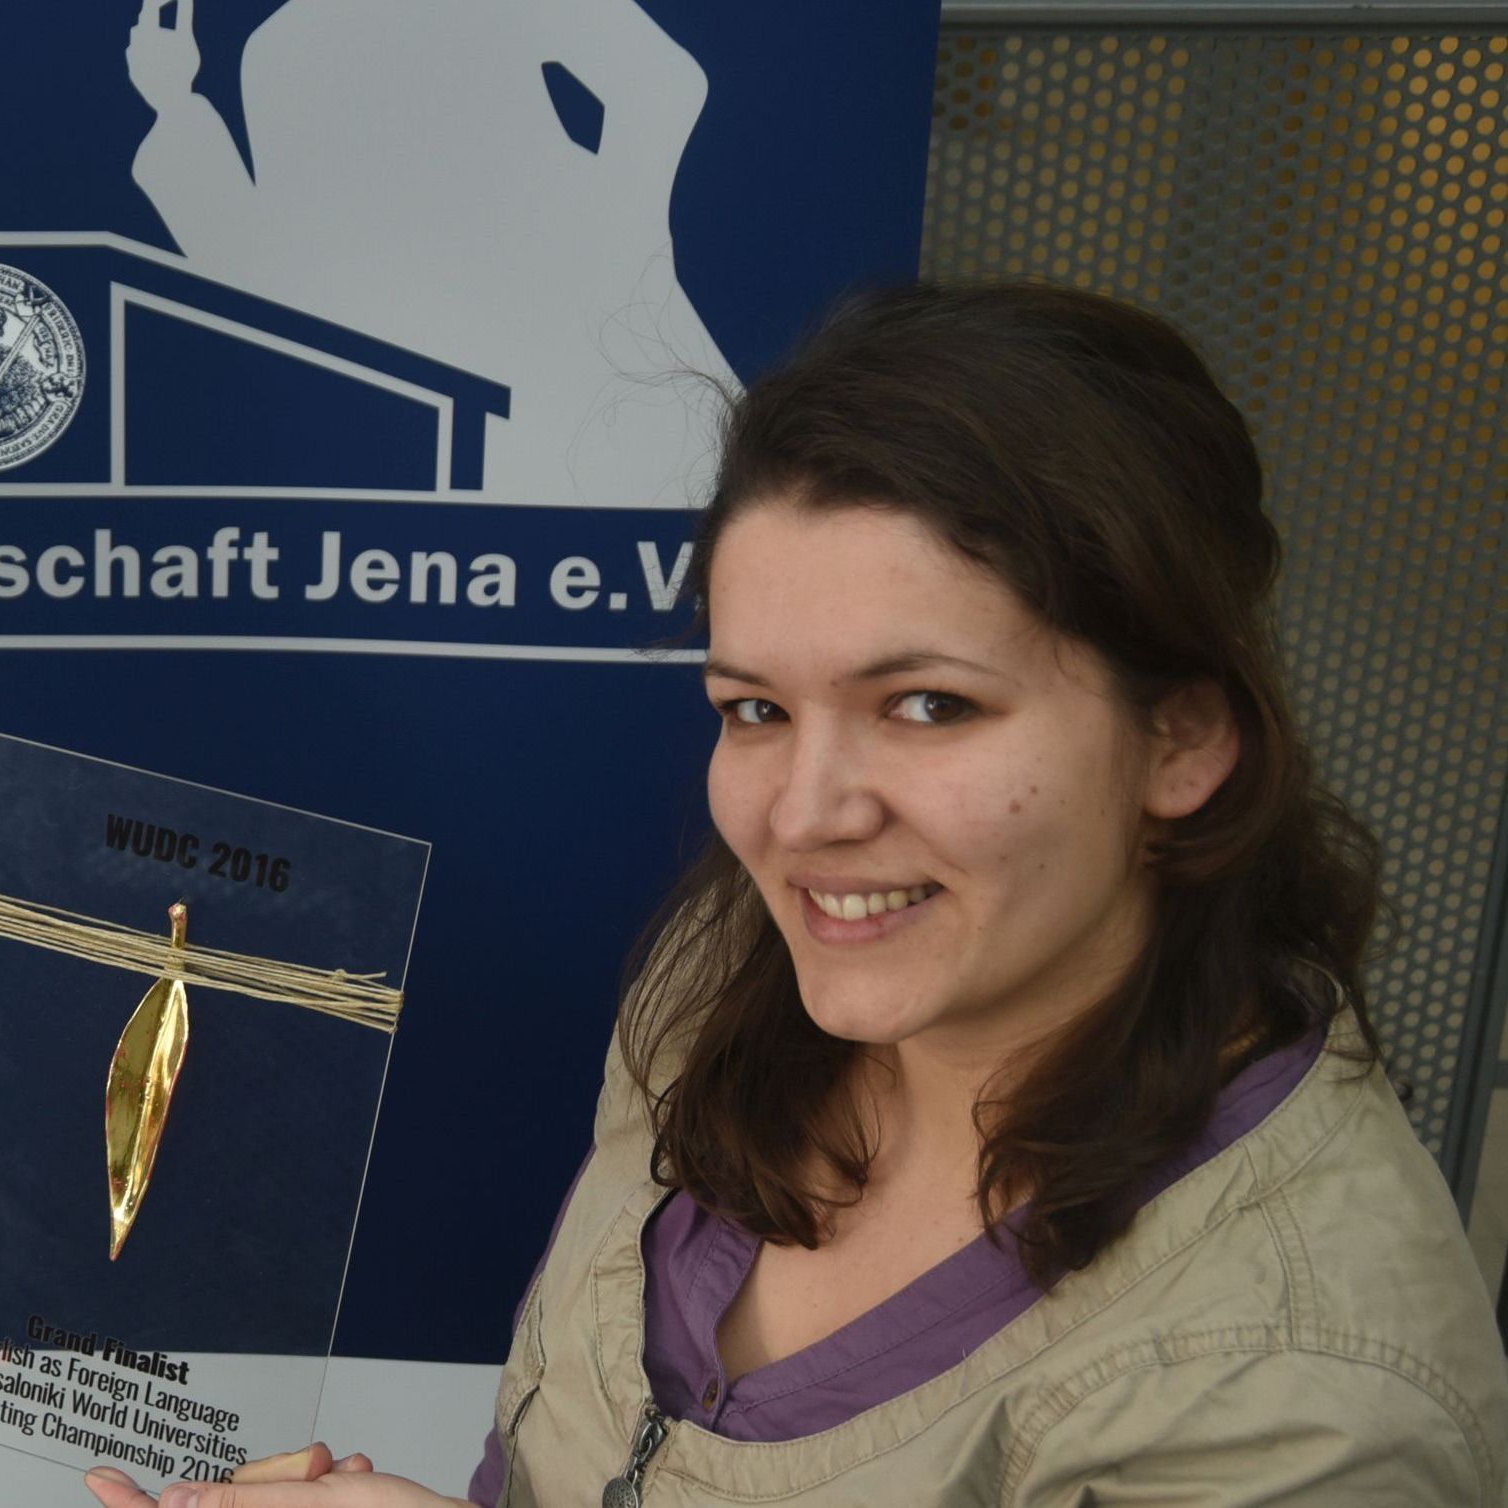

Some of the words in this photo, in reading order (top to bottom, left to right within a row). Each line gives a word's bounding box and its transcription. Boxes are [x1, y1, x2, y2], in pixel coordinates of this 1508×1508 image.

[305, 530, 517, 607] Jena
[106, 813, 200, 869] WUDC
[208, 841, 291, 893] 2016
[27, 1315, 98, 1357] Grand
[103, 1336, 190, 1385] Finalist
[39, 1355, 63, 1378] as
[67, 1357, 140, 1401] Foreign
[144, 1381, 240, 1432] Language
[72, 1389, 128, 1428] World
[133, 1412, 248, 1466] Universities
[41, 1412, 175, 1478] Championship
